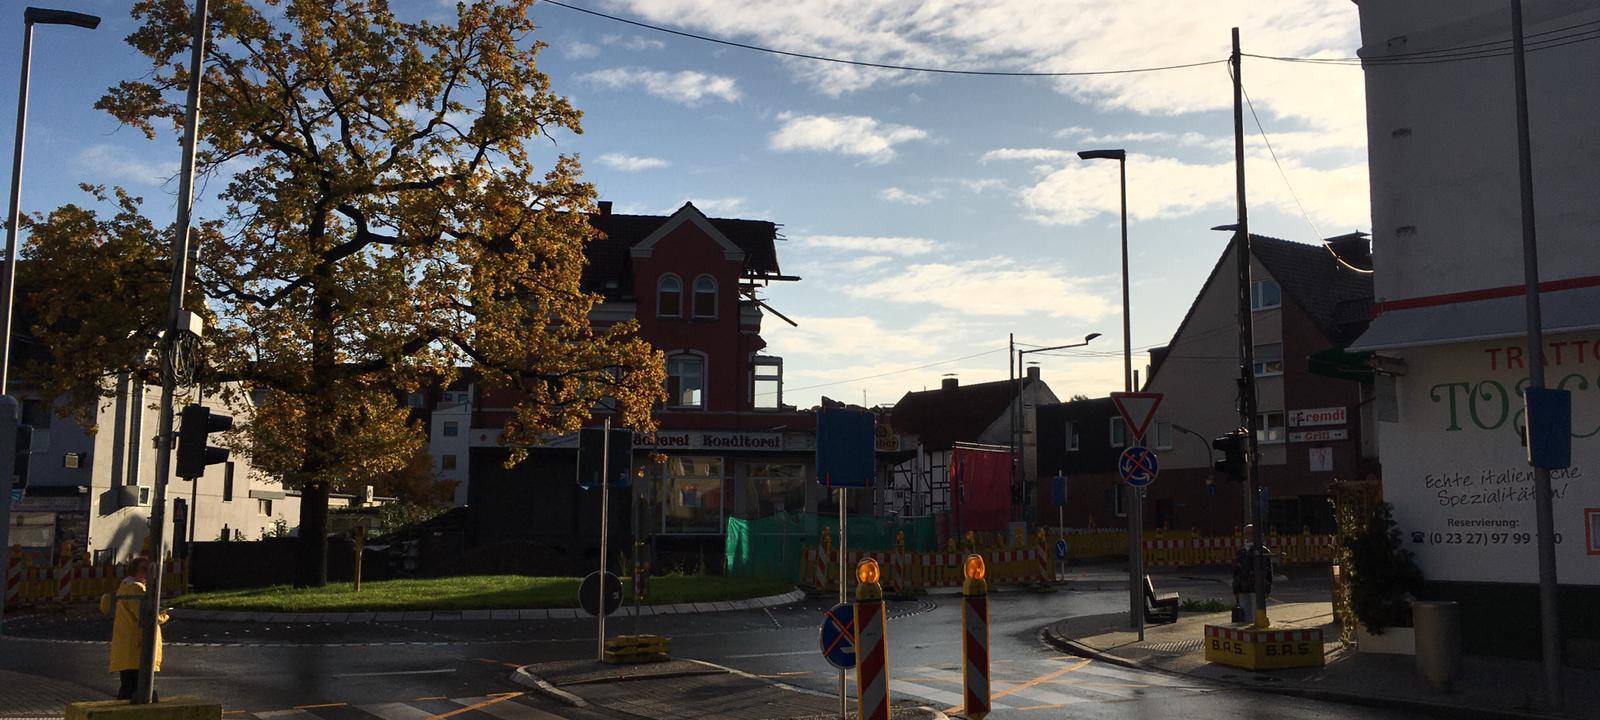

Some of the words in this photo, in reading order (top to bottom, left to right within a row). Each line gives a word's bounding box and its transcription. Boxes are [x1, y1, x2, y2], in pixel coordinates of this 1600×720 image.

[1431, 373, 1600, 439] TOC
[702, 434, 780, 448] Konditorei
[1425, 472, 1473, 489] Echte
[1481, 466, 1582, 485] italienche
[1437, 483, 1568, 507] Spezialitätn!
[1447, 518, 1520, 529] Reservierung:
[1430, 533, 1442, 545] (0
[1446, 533, 1462, 545] 23
[1464, 533, 1488, 546] 27)
[1491, 533, 1509, 545] 97
[1513, 532, 1531, 545] 99
[1212, 639, 1246, 655] B.A.S.
[1266, 643, 1313, 656] B.A.S.
